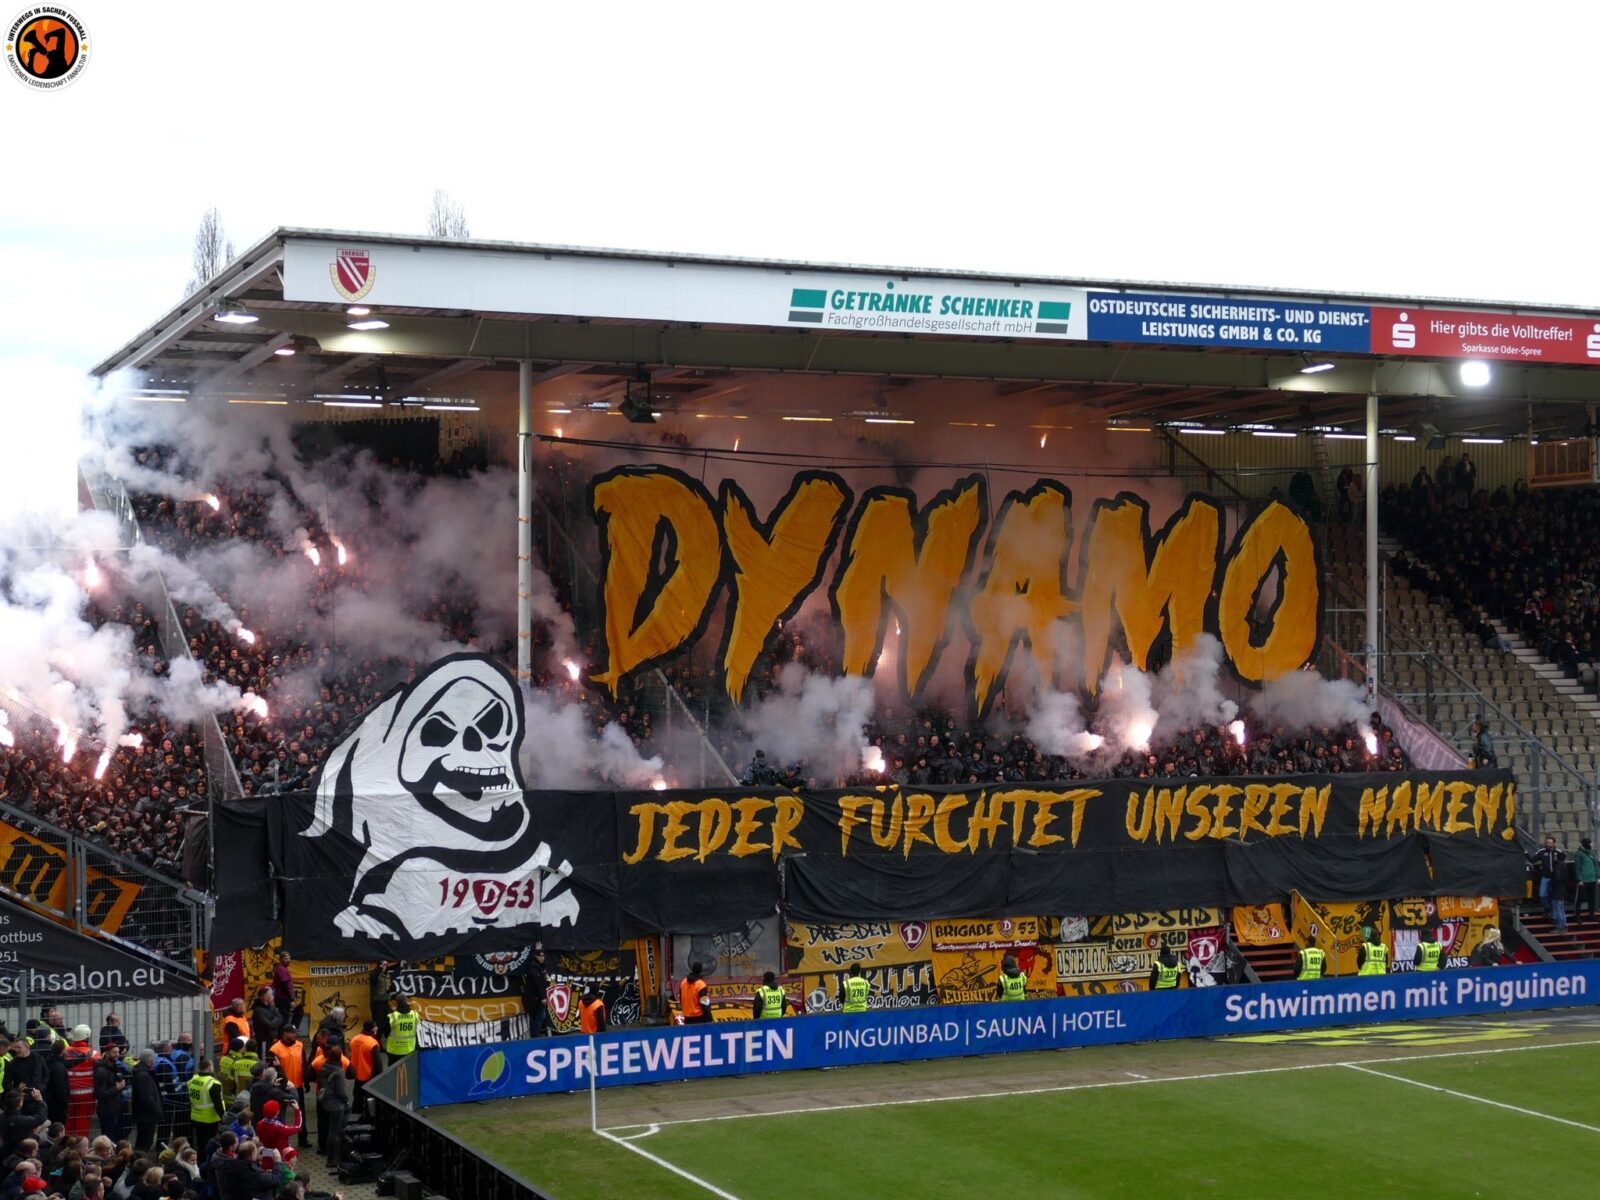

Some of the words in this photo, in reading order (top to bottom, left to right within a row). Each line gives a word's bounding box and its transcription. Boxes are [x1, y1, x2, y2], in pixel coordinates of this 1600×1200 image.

[830, 281, 933, 314] GETRÄNKE
[940, 295, 1033, 318] SCHENKER
[827, 312, 1000, 333] Fachgroßhandelsgesellschaft
[1004, 321, 1032, 333] mbH
[1089, 299, 1186, 318] OSTDEUTSCHE
[1190, 304, 1281, 323] SICHERHEITS-
[1285, 310, 1314, 324] UND
[1319, 312, 1369, 326] DIENST-
[1142, 321, 1215, 339] LEISTUNGS
[1219, 325, 1258, 341] GMBH
[1263, 327, 1273, 340] &
[1277, 328, 1299, 342] CO.
[1303, 329, 1322, 343] KG
[1430, 320, 1455, 334] Hier
[1458, 322, 1488, 338] gibts
[1491, 324, 1509, 338] die
[1512, 325, 1573, 341] Volltreffer!
[1462, 343, 1499, 355] Sparkasse
[1500, 345, 1542, 356] Oder-Spree
[588, 468, 1323, 714] DYNAMO
[622, 796, 805, 864] JEDER
[838, 784, 1103, 861] FÜRCHTET
[1125, 783, 1331, 845] UNSEREN
[1359, 779, 1515, 841] NAMEN!
[1403, 903, 1427, 926] 53
[806, 921, 893, 946] DRESDEN
[935, 923, 994, 938] BRIGADE
[1018, 922, 1037, 935] 53
[821, 944, 884, 965] WEST
[1224, 988, 1397, 1022] Schwimmen
[1404, 980, 1449, 1009] mit
[1456, 973, 1586, 1007] Pinguinen
[824, 1021, 959, 1050] PINGUINBAD
[975, 1015, 1047, 1039] SAUNA
[1062, 1009, 1127, 1032] HOTEL
[525, 1028, 794, 1083] SPREEWELTEN
